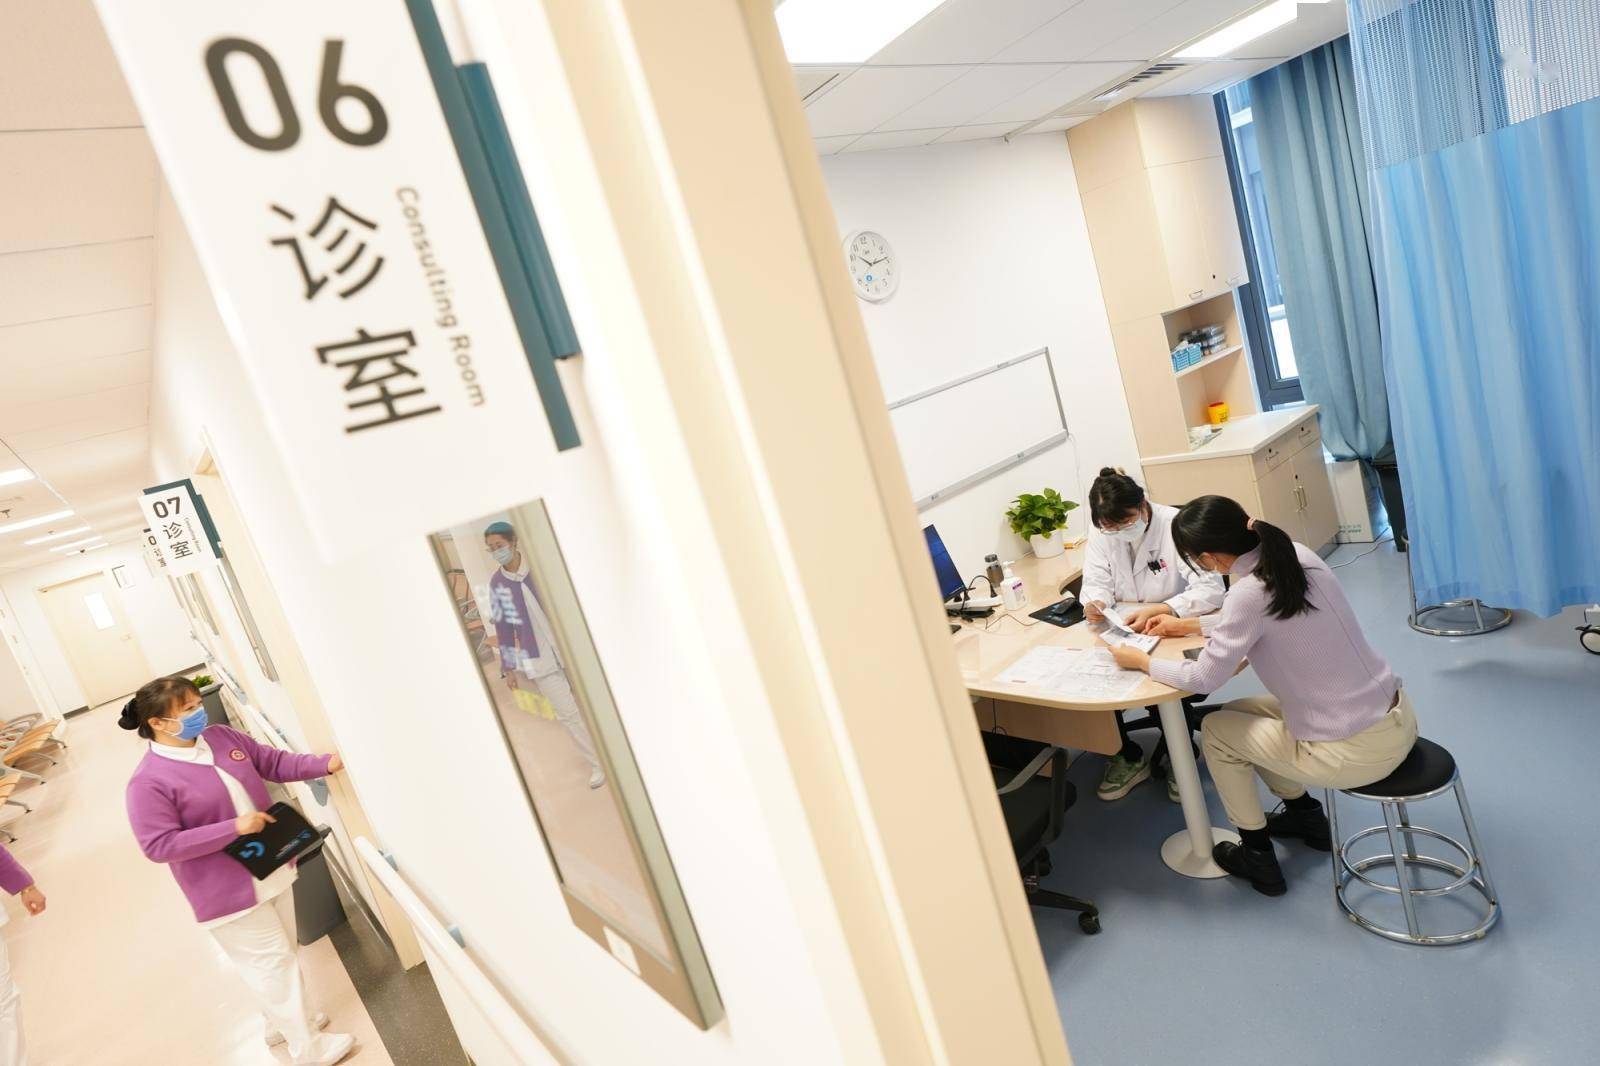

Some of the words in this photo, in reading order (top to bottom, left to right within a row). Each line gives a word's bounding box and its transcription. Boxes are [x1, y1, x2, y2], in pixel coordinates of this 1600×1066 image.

[204, 36, 389, 151] 06
[269, 195, 442, 434] 诊室
[396, 185, 458, 329] Consulting
[450, 334, 487, 408] Room
[152, 496, 181, 518] 07
[162, 521, 194, 559] 诊室
